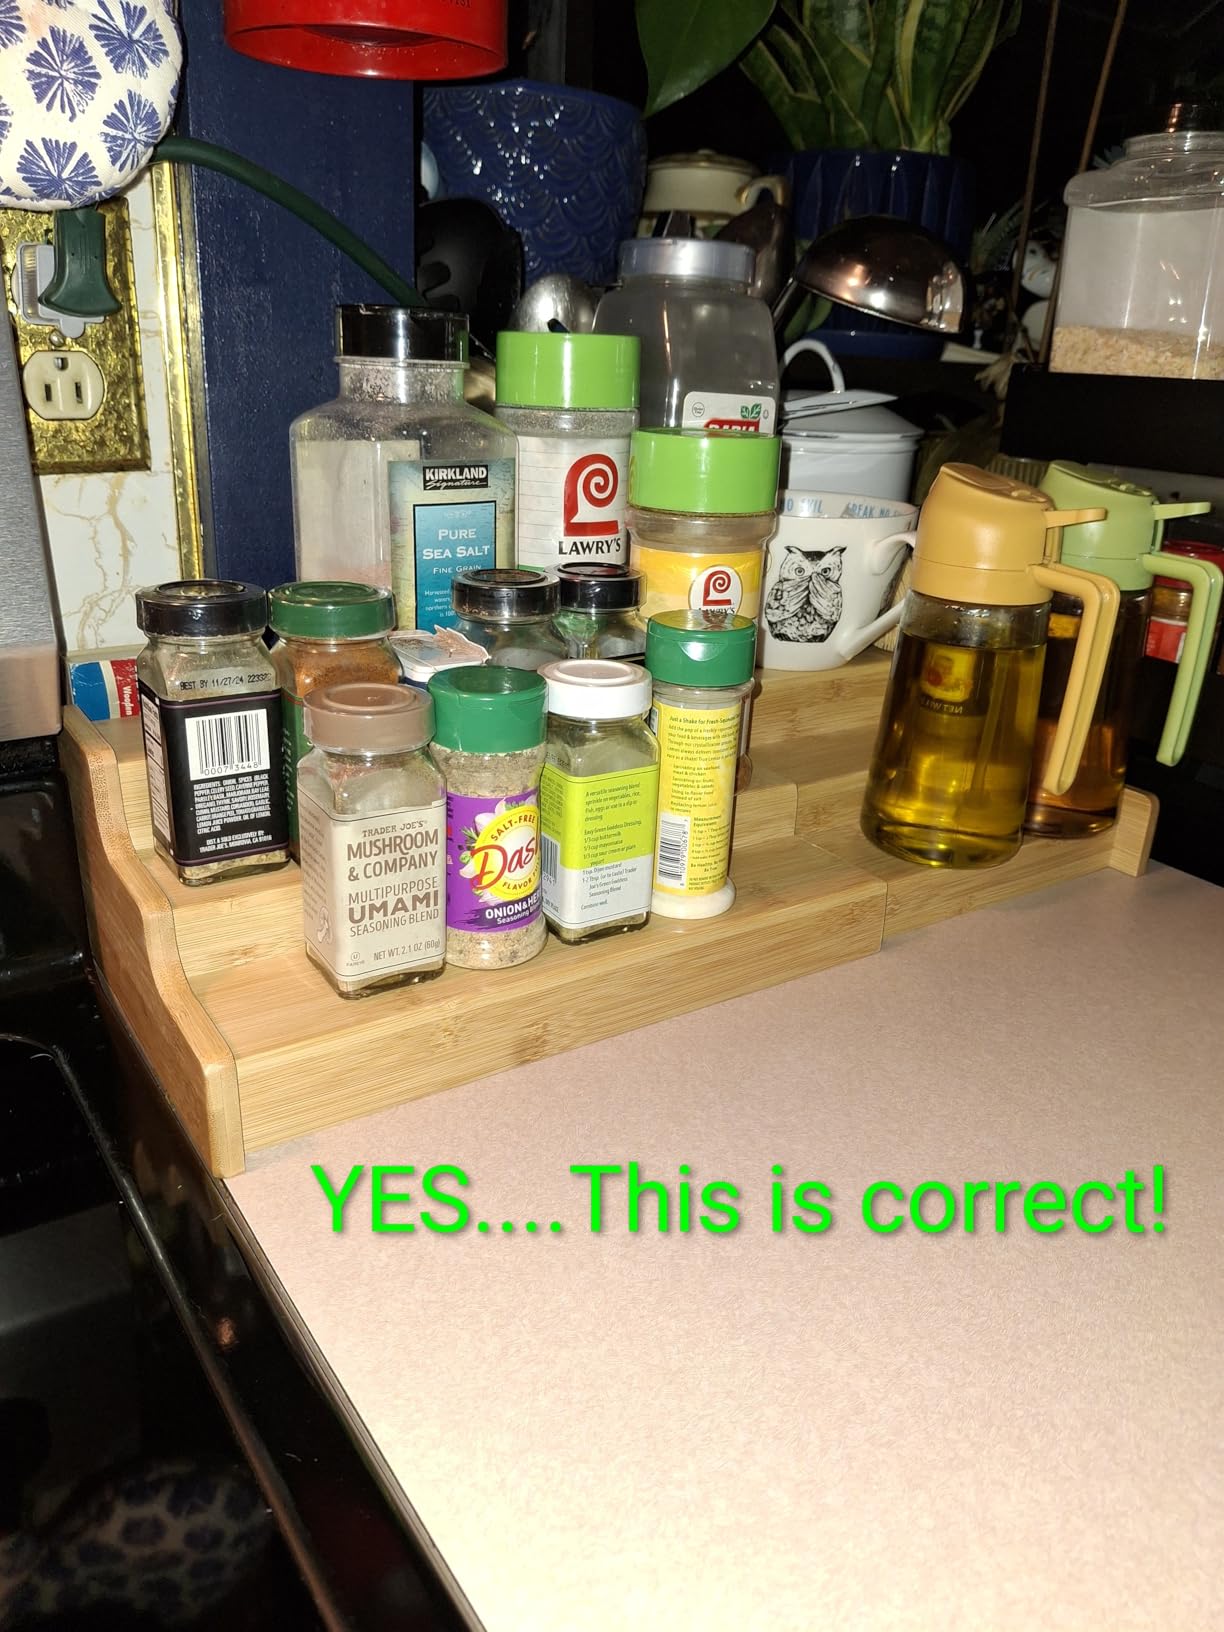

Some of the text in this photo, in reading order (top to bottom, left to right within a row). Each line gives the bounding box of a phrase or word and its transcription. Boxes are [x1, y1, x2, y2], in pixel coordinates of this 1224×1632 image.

[425, 466, 487, 481] KIRKLAND
[426, 479, 487, 490] Signature
[438, 528, 477, 540] PURE
[422, 546, 490, 560] SEA SALT
[558, 537, 621, 555] LAWRY'S
[181, 681, 196, 690] BEST
[200, 680, 208, 688] BY
[212, 676, 243, 687] 11/27/24
[122, 686, 134, 716] Wooden
[204, 762, 259, 776] 0007 3448
[362, 821, 424, 838] TRADER JOE'S
[490, 814, 536, 842] SALT-FREE
[346, 828, 439, 861] MUSHROOM
[348, 850, 438, 882] & COMPANY
[469, 836, 537, 891] Das
[348, 876, 439, 906] MULTIPURPOSE
[502, 877, 532, 890] FLAVOR
[348, 889, 439, 924] UMAMI
[485, 902, 522, 919] ONION
[349, 909, 439, 938] SEASONING BLEND
[497, 910, 529, 925] Seasoning
[374, 938, 440, 960] NET WT. 2.1 OZ (60g)
